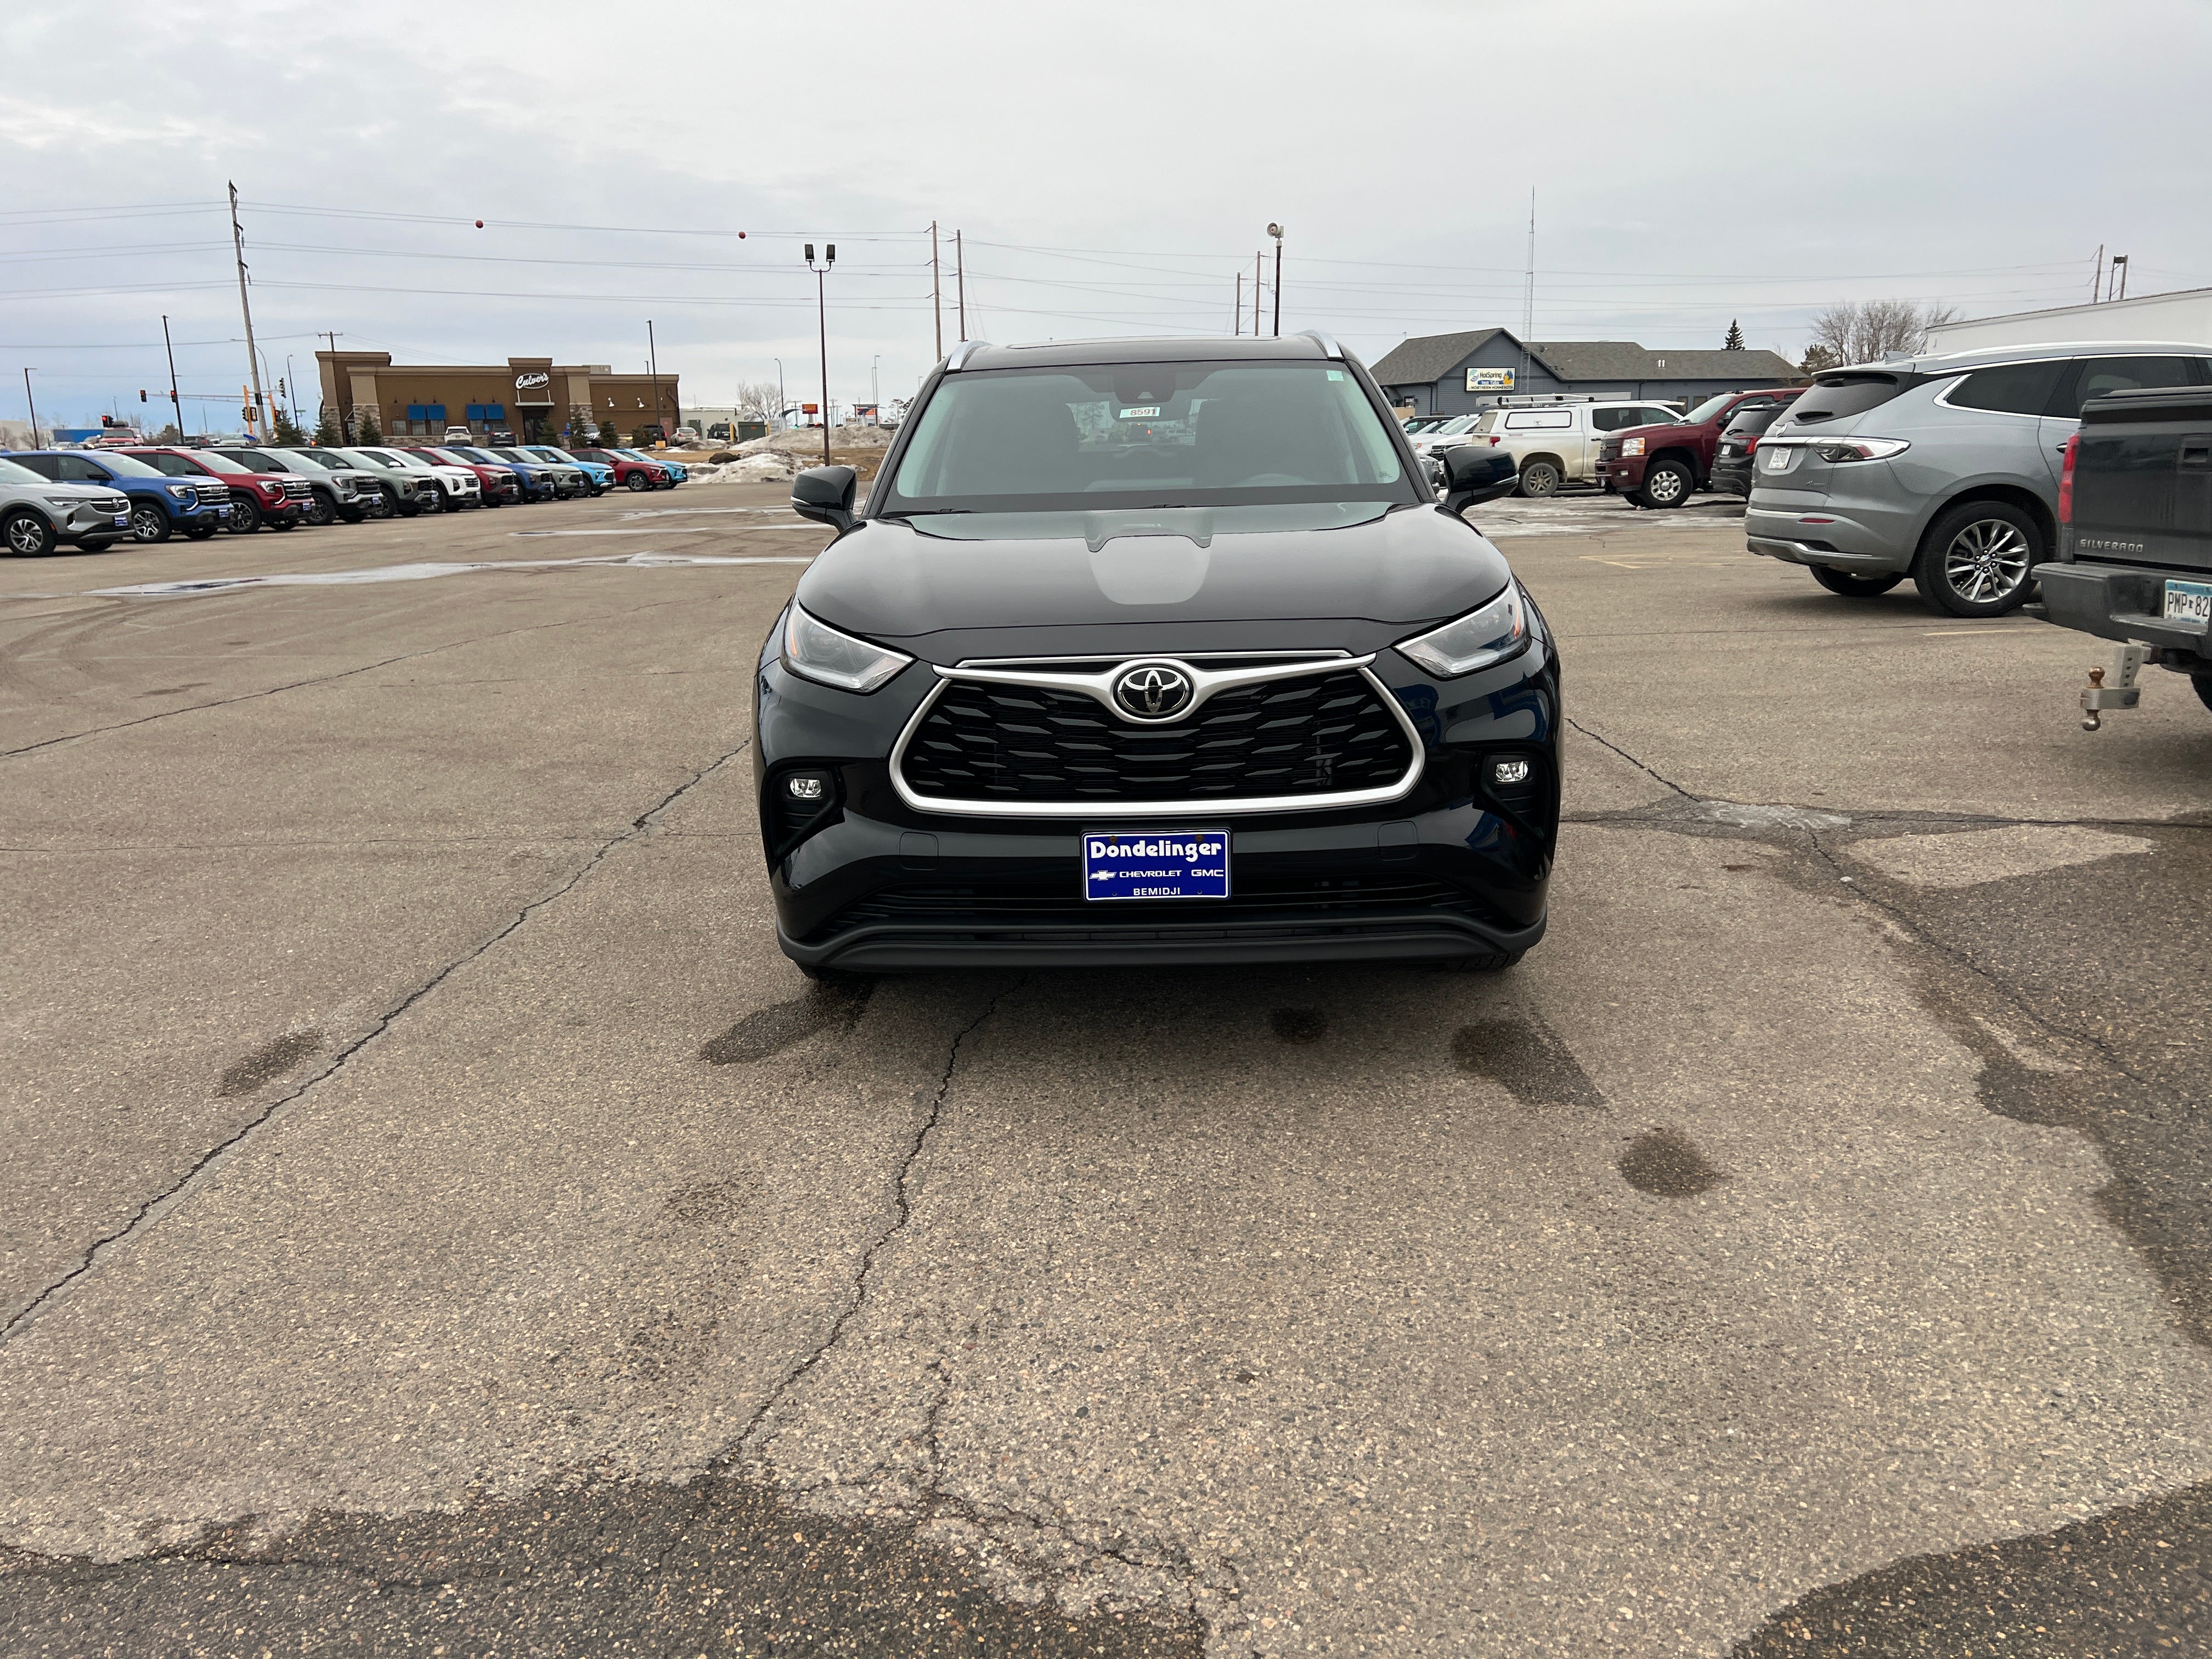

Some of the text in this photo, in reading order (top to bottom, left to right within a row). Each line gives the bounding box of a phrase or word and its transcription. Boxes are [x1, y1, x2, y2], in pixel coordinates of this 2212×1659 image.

[516, 373, 549, 389] Culver's
[2080, 539, 2143, 552] SILVERADO
[1090, 840, 1221, 862] Dondelinger
[1133, 887, 1180, 895] BEMIDJI
